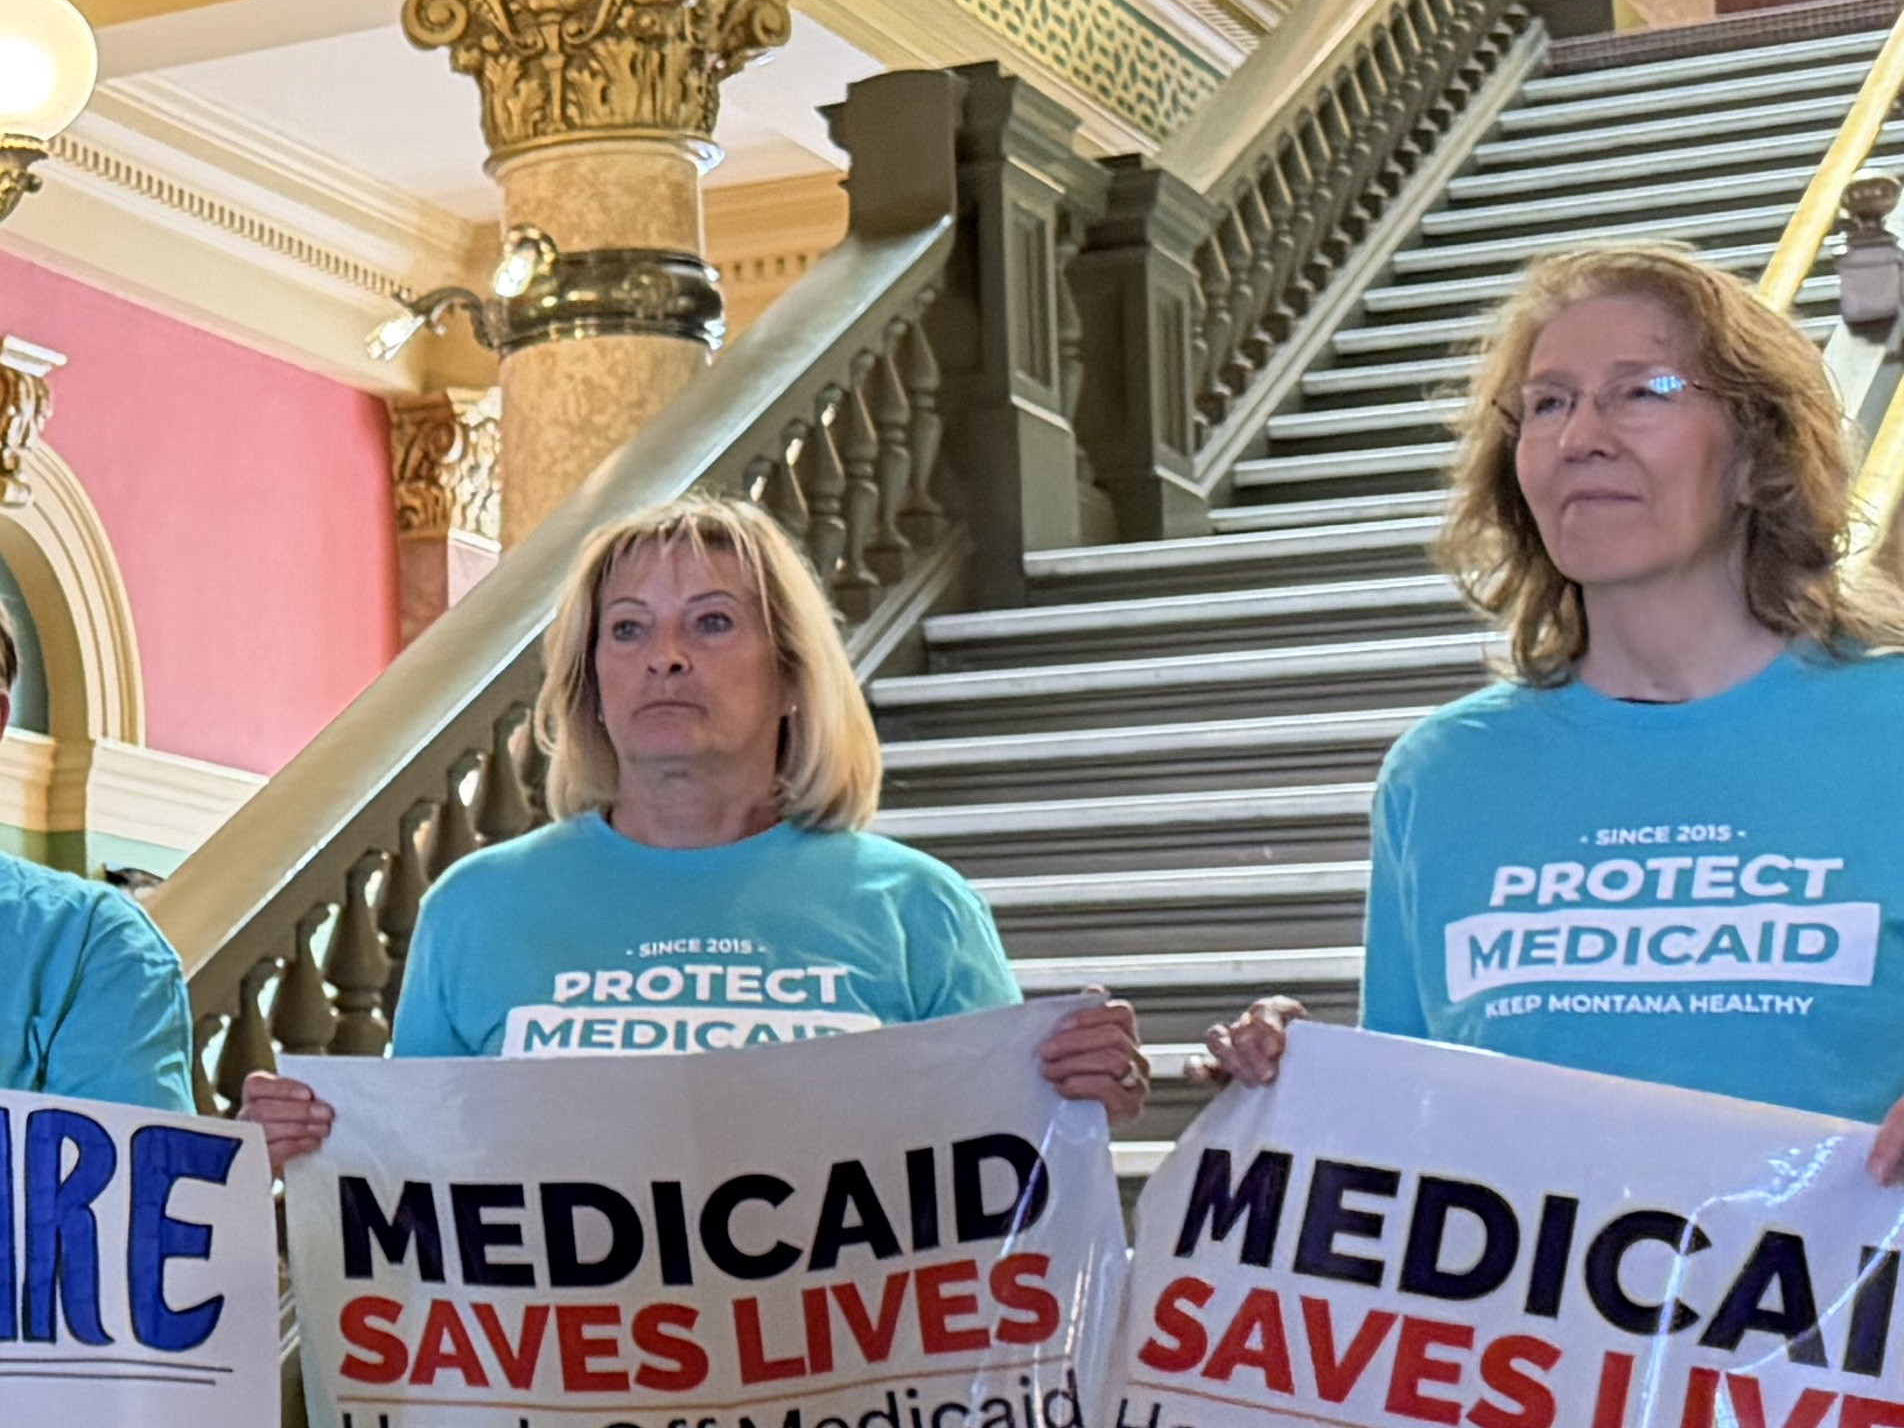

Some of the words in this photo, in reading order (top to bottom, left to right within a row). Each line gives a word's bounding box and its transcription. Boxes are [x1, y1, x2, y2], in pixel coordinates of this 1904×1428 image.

[1595, 826, 1670, 846] SINCE
[1676, 825, 1731, 843] 2015
[1489, 854, 1844, 907] PROTECT
[638, 938, 703, 958] SINCE
[706, 938, 753, 954] 2015
[1469, 920, 1840, 980] MEDICAID
[553, 964, 849, 1004] PROTECT
[1485, 995, 1542, 1019] KEEP
[1548, 994, 1684, 1014] MONTANA
[1689, 995, 1814, 1016] HEALTHY
[523, 1018, 849, 1053] MEDICAI
[338, 1132, 1051, 1289] MEDICAID
[1174, 1148, 1901, 1378] MEDICAI
[339, 1295, 710, 1393] SAVES
[731, 1252, 1060, 1386] LIVES
